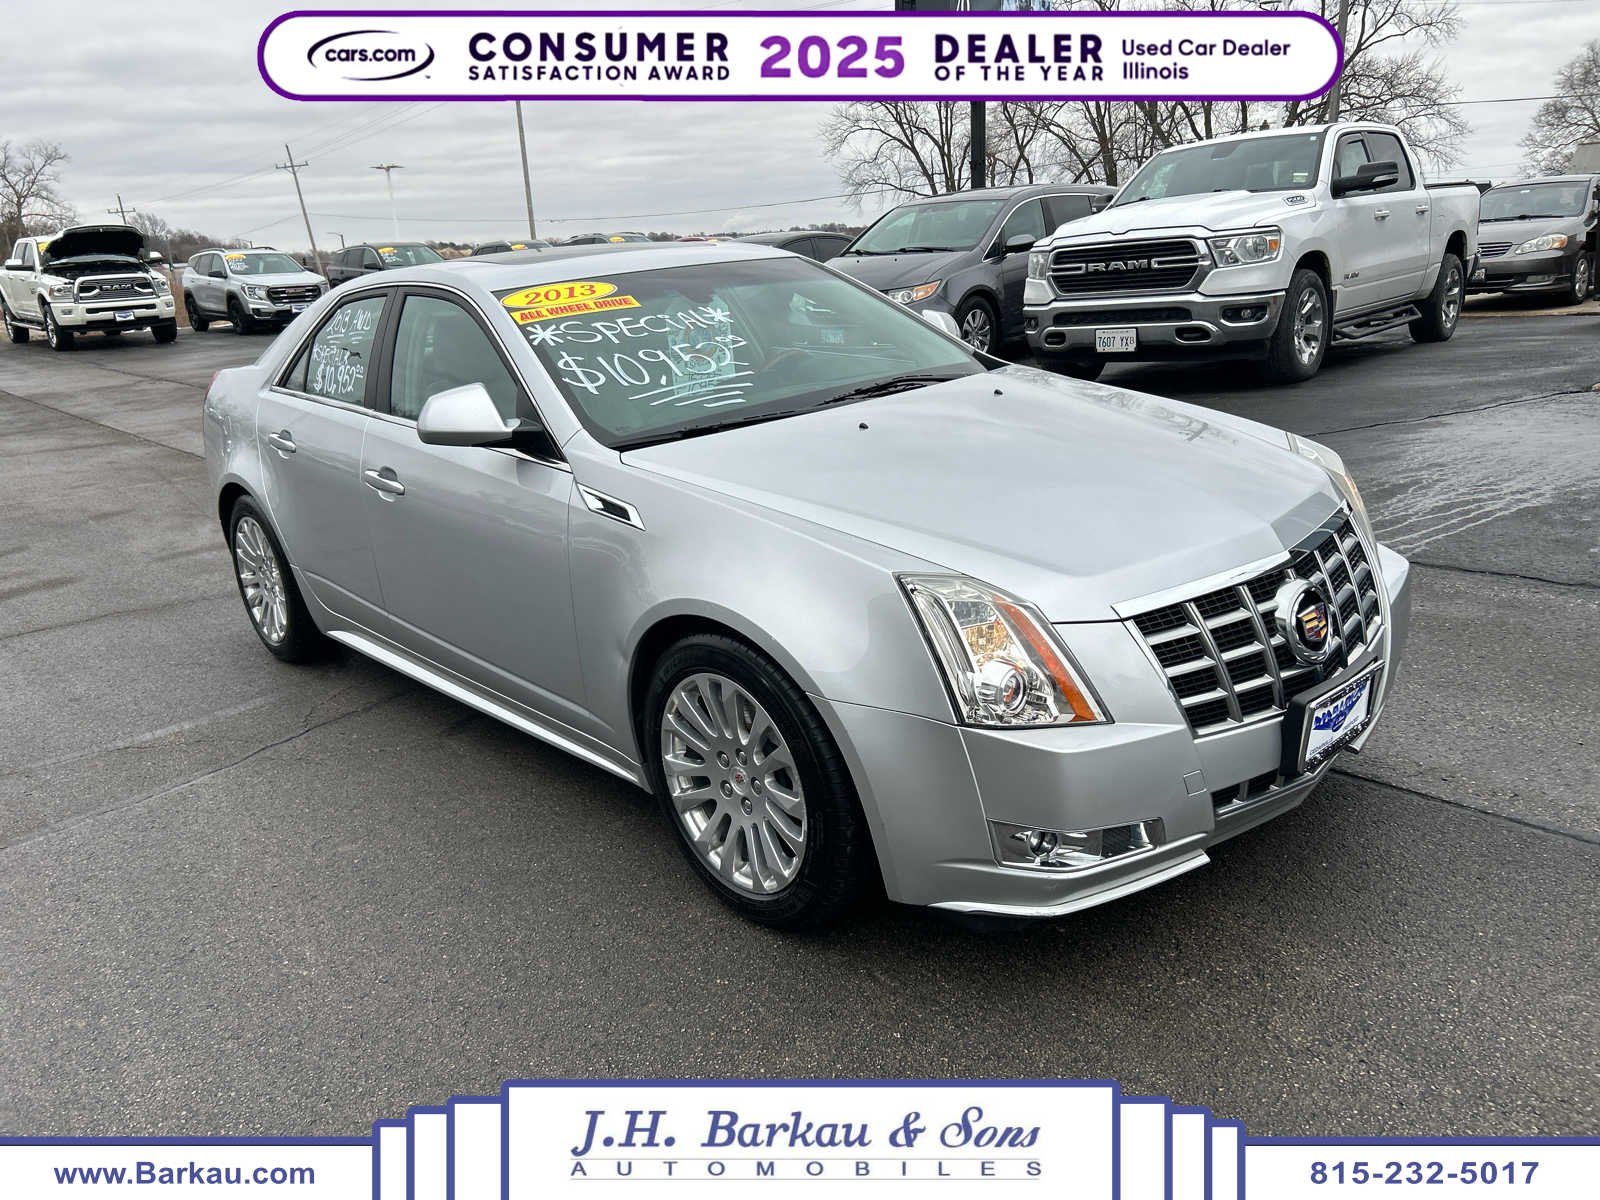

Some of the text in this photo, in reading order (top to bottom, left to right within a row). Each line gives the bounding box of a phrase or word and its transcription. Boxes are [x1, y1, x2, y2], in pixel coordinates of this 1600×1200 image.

[1087, 260, 1148, 272] RAM
[524, 284, 597, 306] 2013
[520, 296, 632, 321] ALL WHEEL DRIVE
[1097, 336, 1116, 348] 7607
